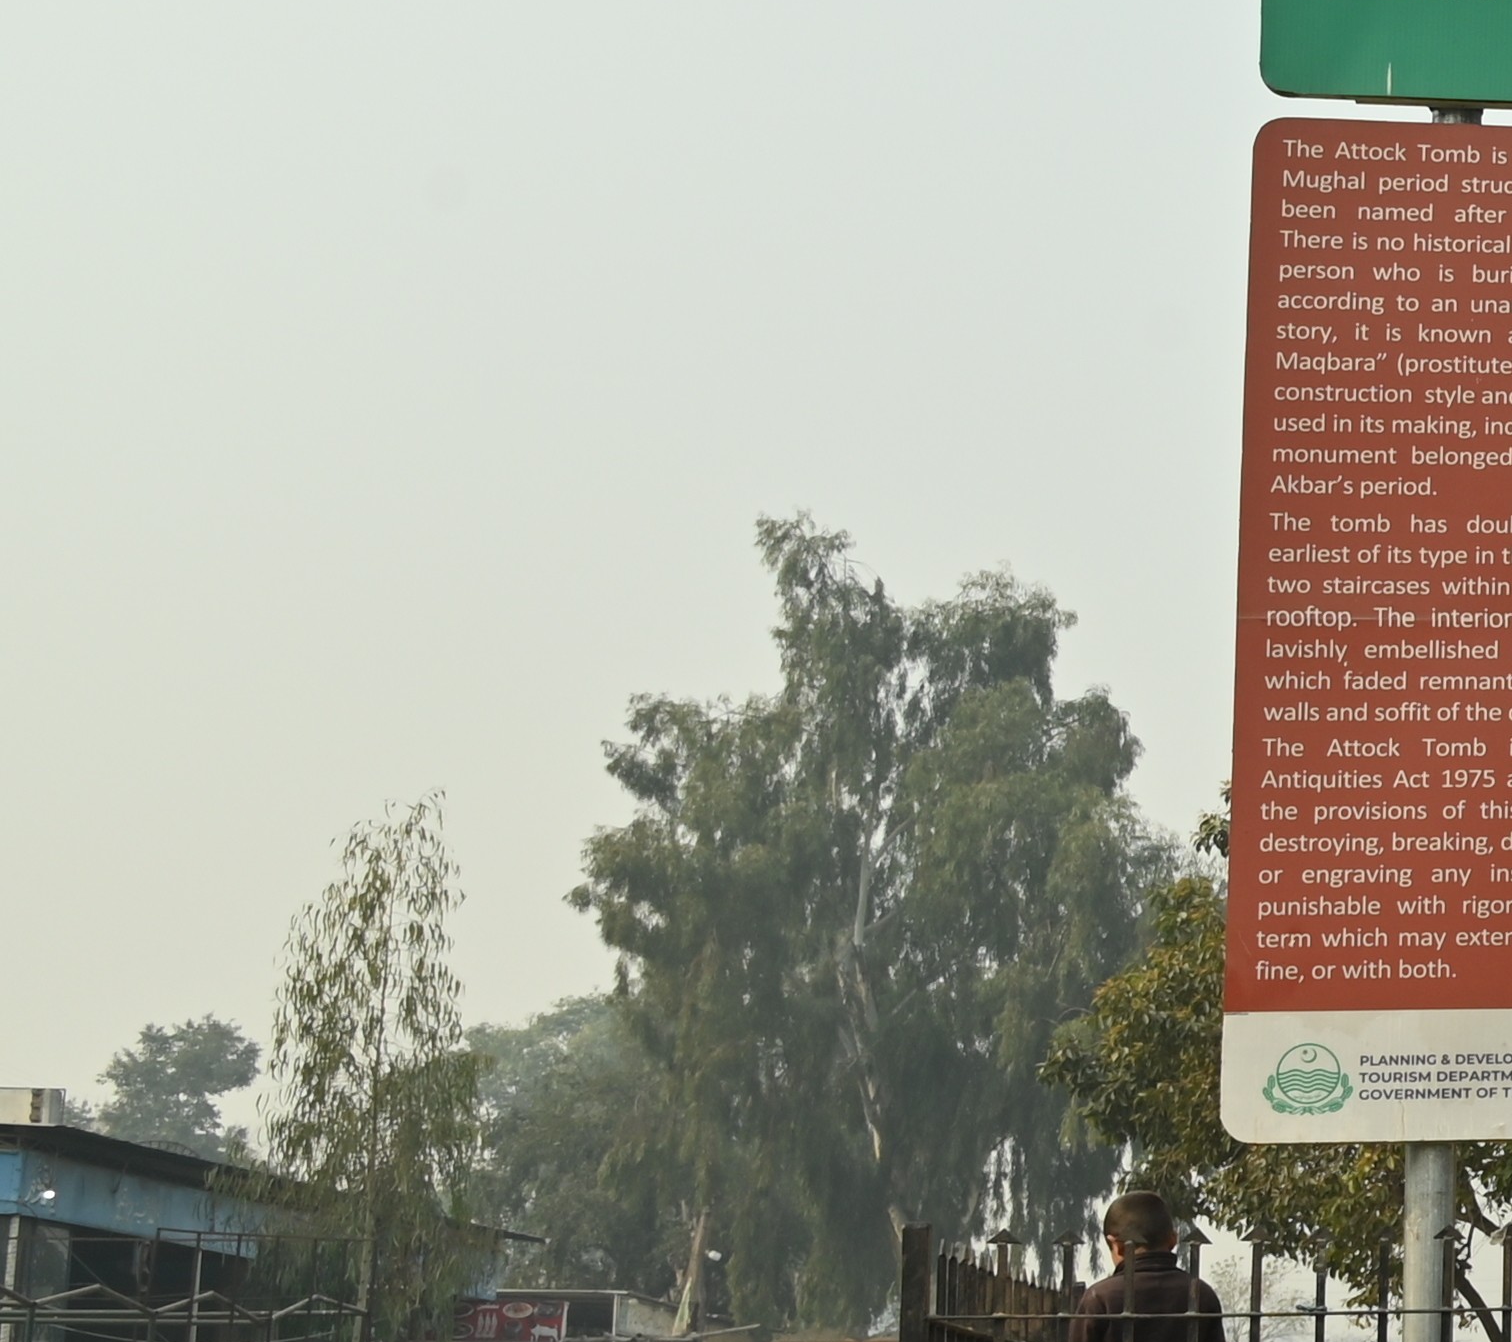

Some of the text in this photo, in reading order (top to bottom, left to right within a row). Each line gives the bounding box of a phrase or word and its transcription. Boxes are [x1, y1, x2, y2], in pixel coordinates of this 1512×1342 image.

[1282, 139, 1324, 159] The
[1334, 141, 1407, 161] Attock
[1417, 144, 1481, 164] Tomb
[1492, 146, 1508, 165] is
[1283, 169, 1365, 193] Mughal
[1378, 173, 1449, 195] period
[1281, 198, 1336, 219] been
[1358, 203, 1434, 222] named
[1454, 203, 1507, 224] after
[1279, 229, 1344, 250] There
[1352, 231, 1368, 250] is
[1377, 237, 1405, 251] no
[1413, 232, 1511, 254] historical
[1279, 264, 1354, 282] person
[1372, 262, 1421, 282] who
[1438, 264, 1454, 283] is
[1277, 291, 1385, 315] according
[1396, 294, 1420, 312] to
[1431, 298, 1458, 312] an
[1276, 322, 1338, 344] story,
[1355, 322, 1370, 341] it
[1386, 323, 1402, 342] is
[1418, 323, 1491, 344] known
[1274, 384, 1412, 403] construction
[1425, 384, 1475, 408] style
[1274, 413, 1326, 432] used
[1333, 414, 1352, 433] in
[1360, 414, 1385, 433] its
[1392, 415, 1477, 439] making,
[1273, 447, 1397, 465] monument
[1411, 445, 1512, 470] belonged
[1255, 958, 1457, 983] fine, or with both.
[1360, 1054, 1437, 1067] PLANNING
[1440, 1053, 1451, 1066] &
[1359, 1071, 1432, 1084] TOURISM
[1358, 1087, 1472, 1101] GOVERNMENT
[1476, 1087, 1498, 1099] OF
